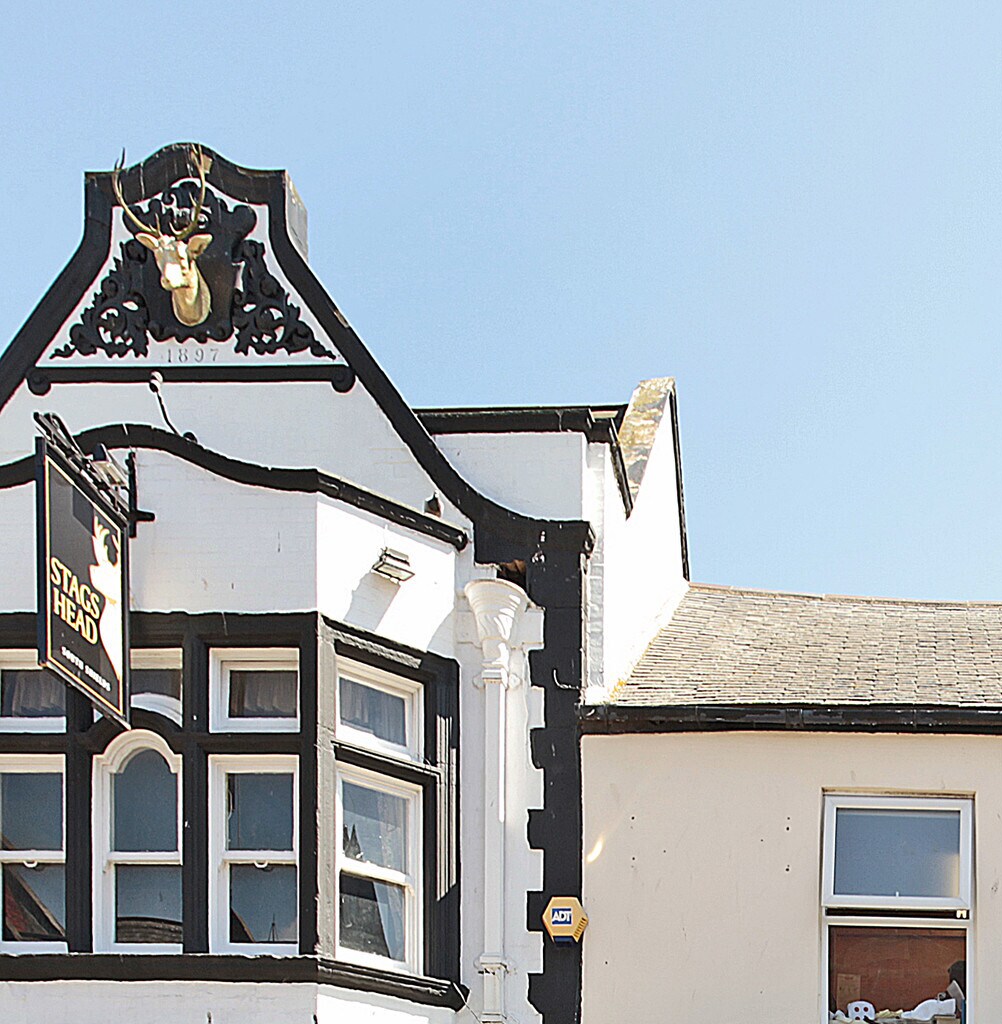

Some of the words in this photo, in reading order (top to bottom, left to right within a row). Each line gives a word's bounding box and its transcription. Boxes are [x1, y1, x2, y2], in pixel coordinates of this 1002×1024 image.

[167, 348, 219, 363] 1897
[50, 556, 100, 620] STAGS
[52, 586, 99, 645] HEAD
[552, 910, 572, 922] ADT
